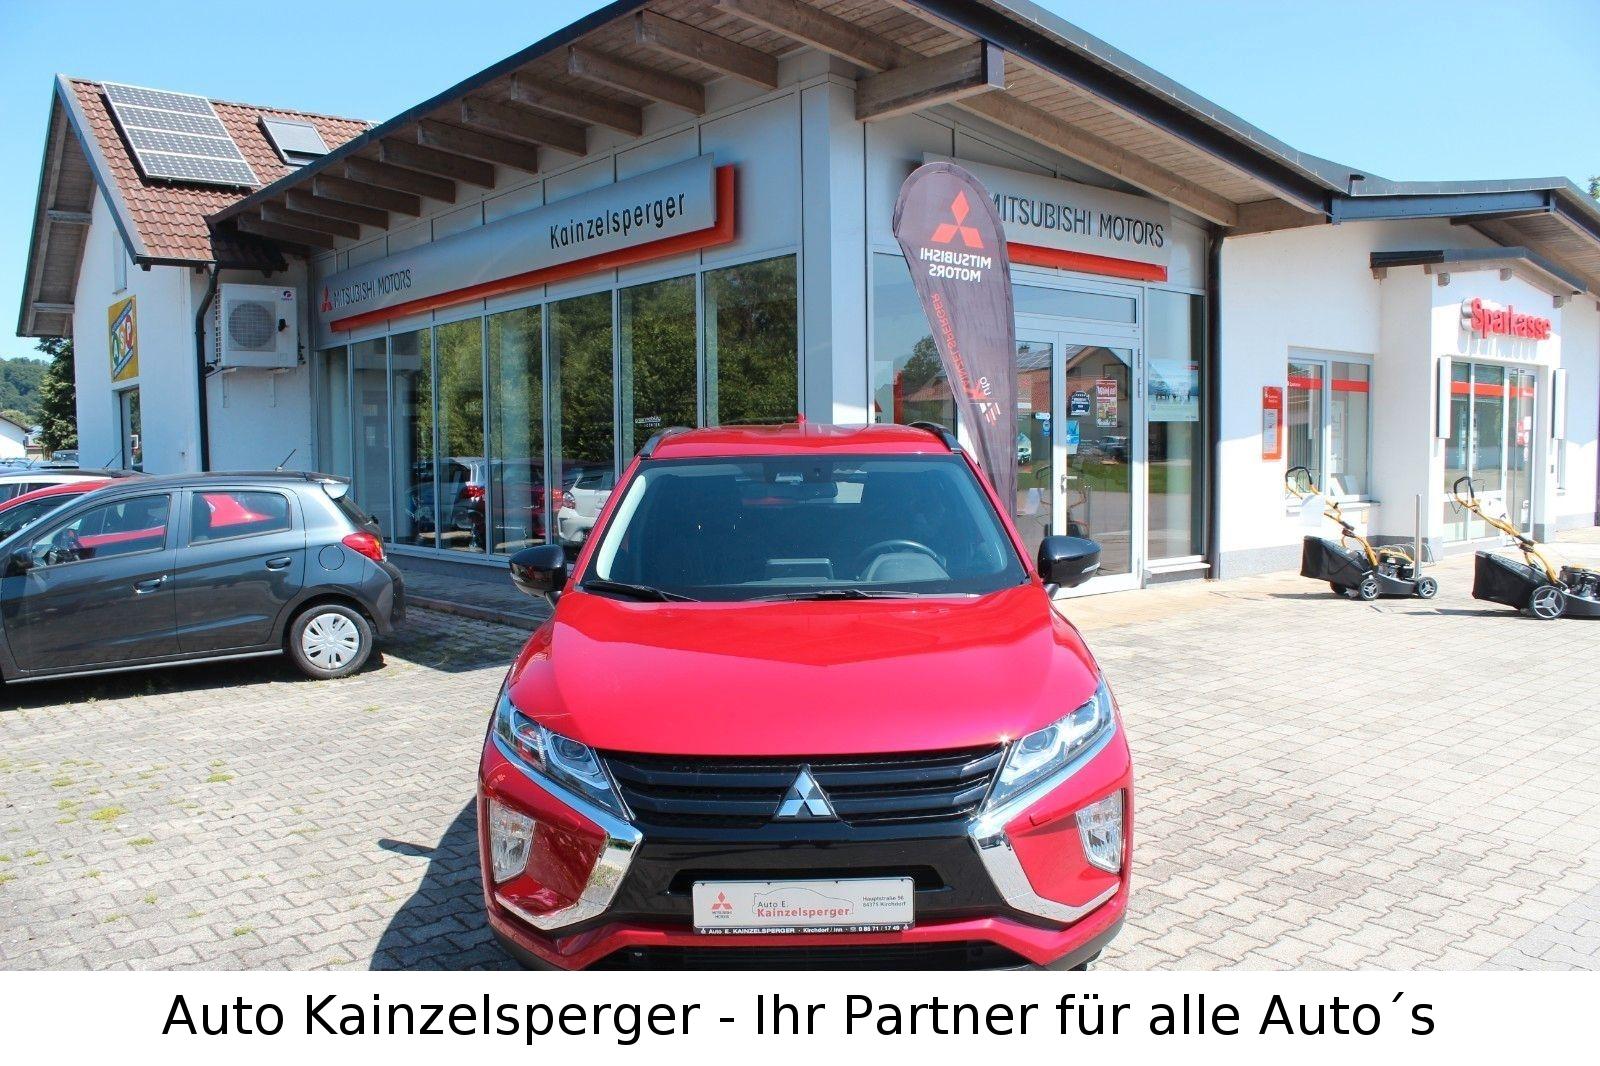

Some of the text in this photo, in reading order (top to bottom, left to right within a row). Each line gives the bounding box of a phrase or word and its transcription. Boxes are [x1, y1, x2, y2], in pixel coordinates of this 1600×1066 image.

[549, 192, 686, 250] Kainzelsperger
[1099, 212, 1164, 248] MOTORS
[333, 268, 412, 309] MITSUBISHI MOTORS
[1467, 297, 1551, 340] Sparkasse
[757, 907, 849, 918] Kainzelsperger
[781, 900, 789, 908] E.
